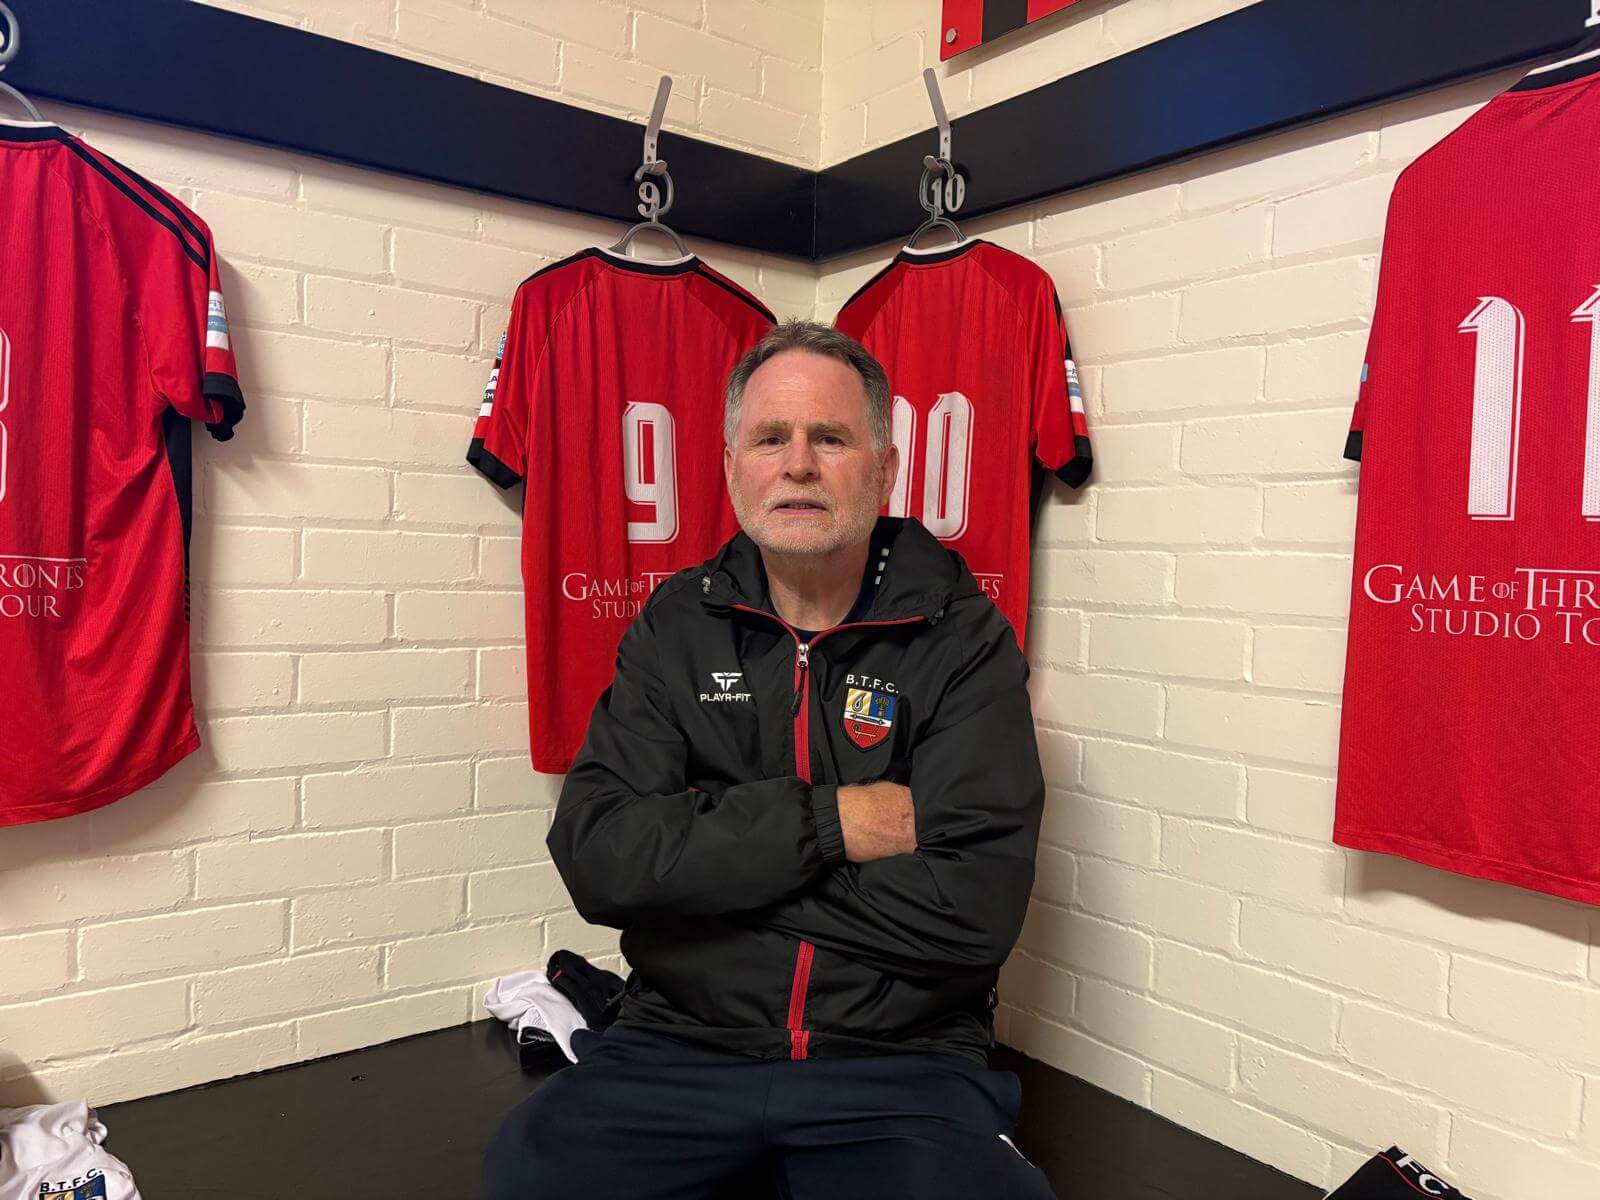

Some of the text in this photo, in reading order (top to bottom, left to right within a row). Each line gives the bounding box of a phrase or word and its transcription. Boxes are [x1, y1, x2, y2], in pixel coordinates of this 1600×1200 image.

[637, 181, 660, 218] 9
[931, 173, 965, 215] 10
[622, 401, 680, 544] 9
[562, 572, 630, 600] GAME
[631, 580, 646, 593] OF
[1363, 564, 1600, 610] GAME OF THR
[0, 594, 62, 618] OUR
[592, 599, 640, 619] STUDI
[1410, 603, 1600, 646] STUDIO TO
[699, 693, 751, 702] PLAYR-FIT
[846, 674, 899, 694] B.T.F.C.
[39, 1168, 102, 1192] B.T.F.C.
